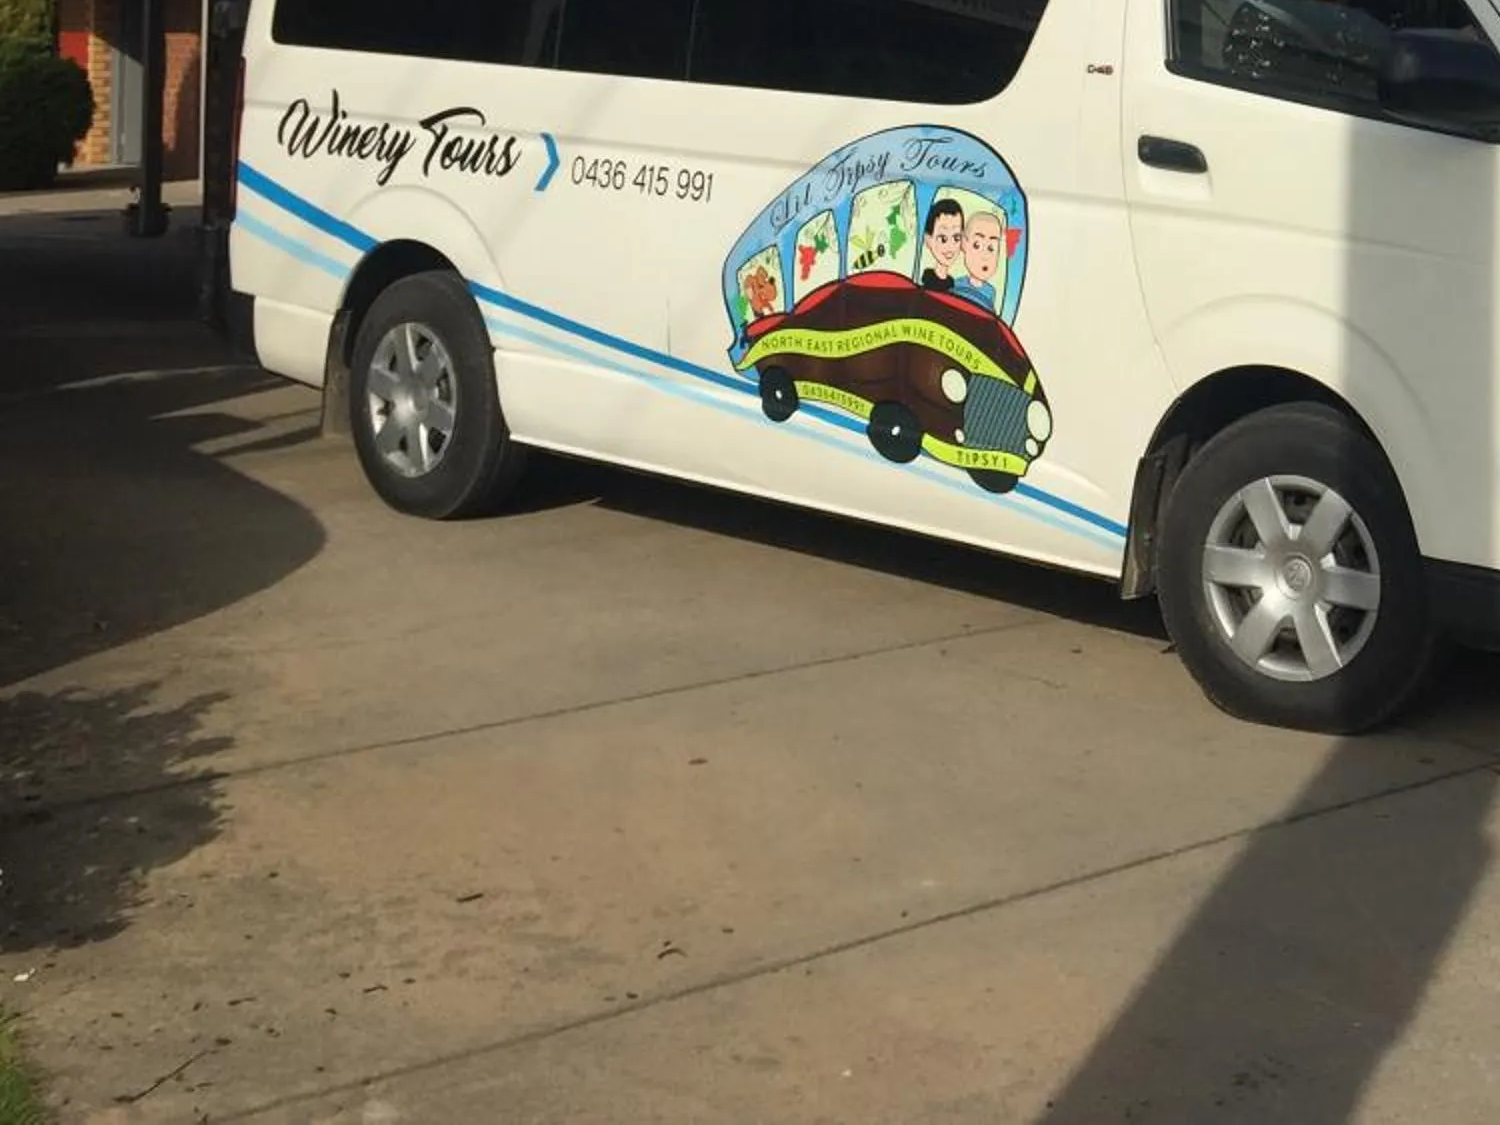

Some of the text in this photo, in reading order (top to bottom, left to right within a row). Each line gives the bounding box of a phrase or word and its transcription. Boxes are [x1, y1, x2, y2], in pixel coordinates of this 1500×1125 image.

[277, 88, 522, 186] Winery Tours
[571, 156, 714, 203] 0436 415 991
[824, 146, 891, 203] Tipsy
[901, 136, 987, 178] Tours
[761, 325, 982, 371] NORTH EAST REGIONAL WINE TOURS
[956, 450, 998, 467] TIPSY
